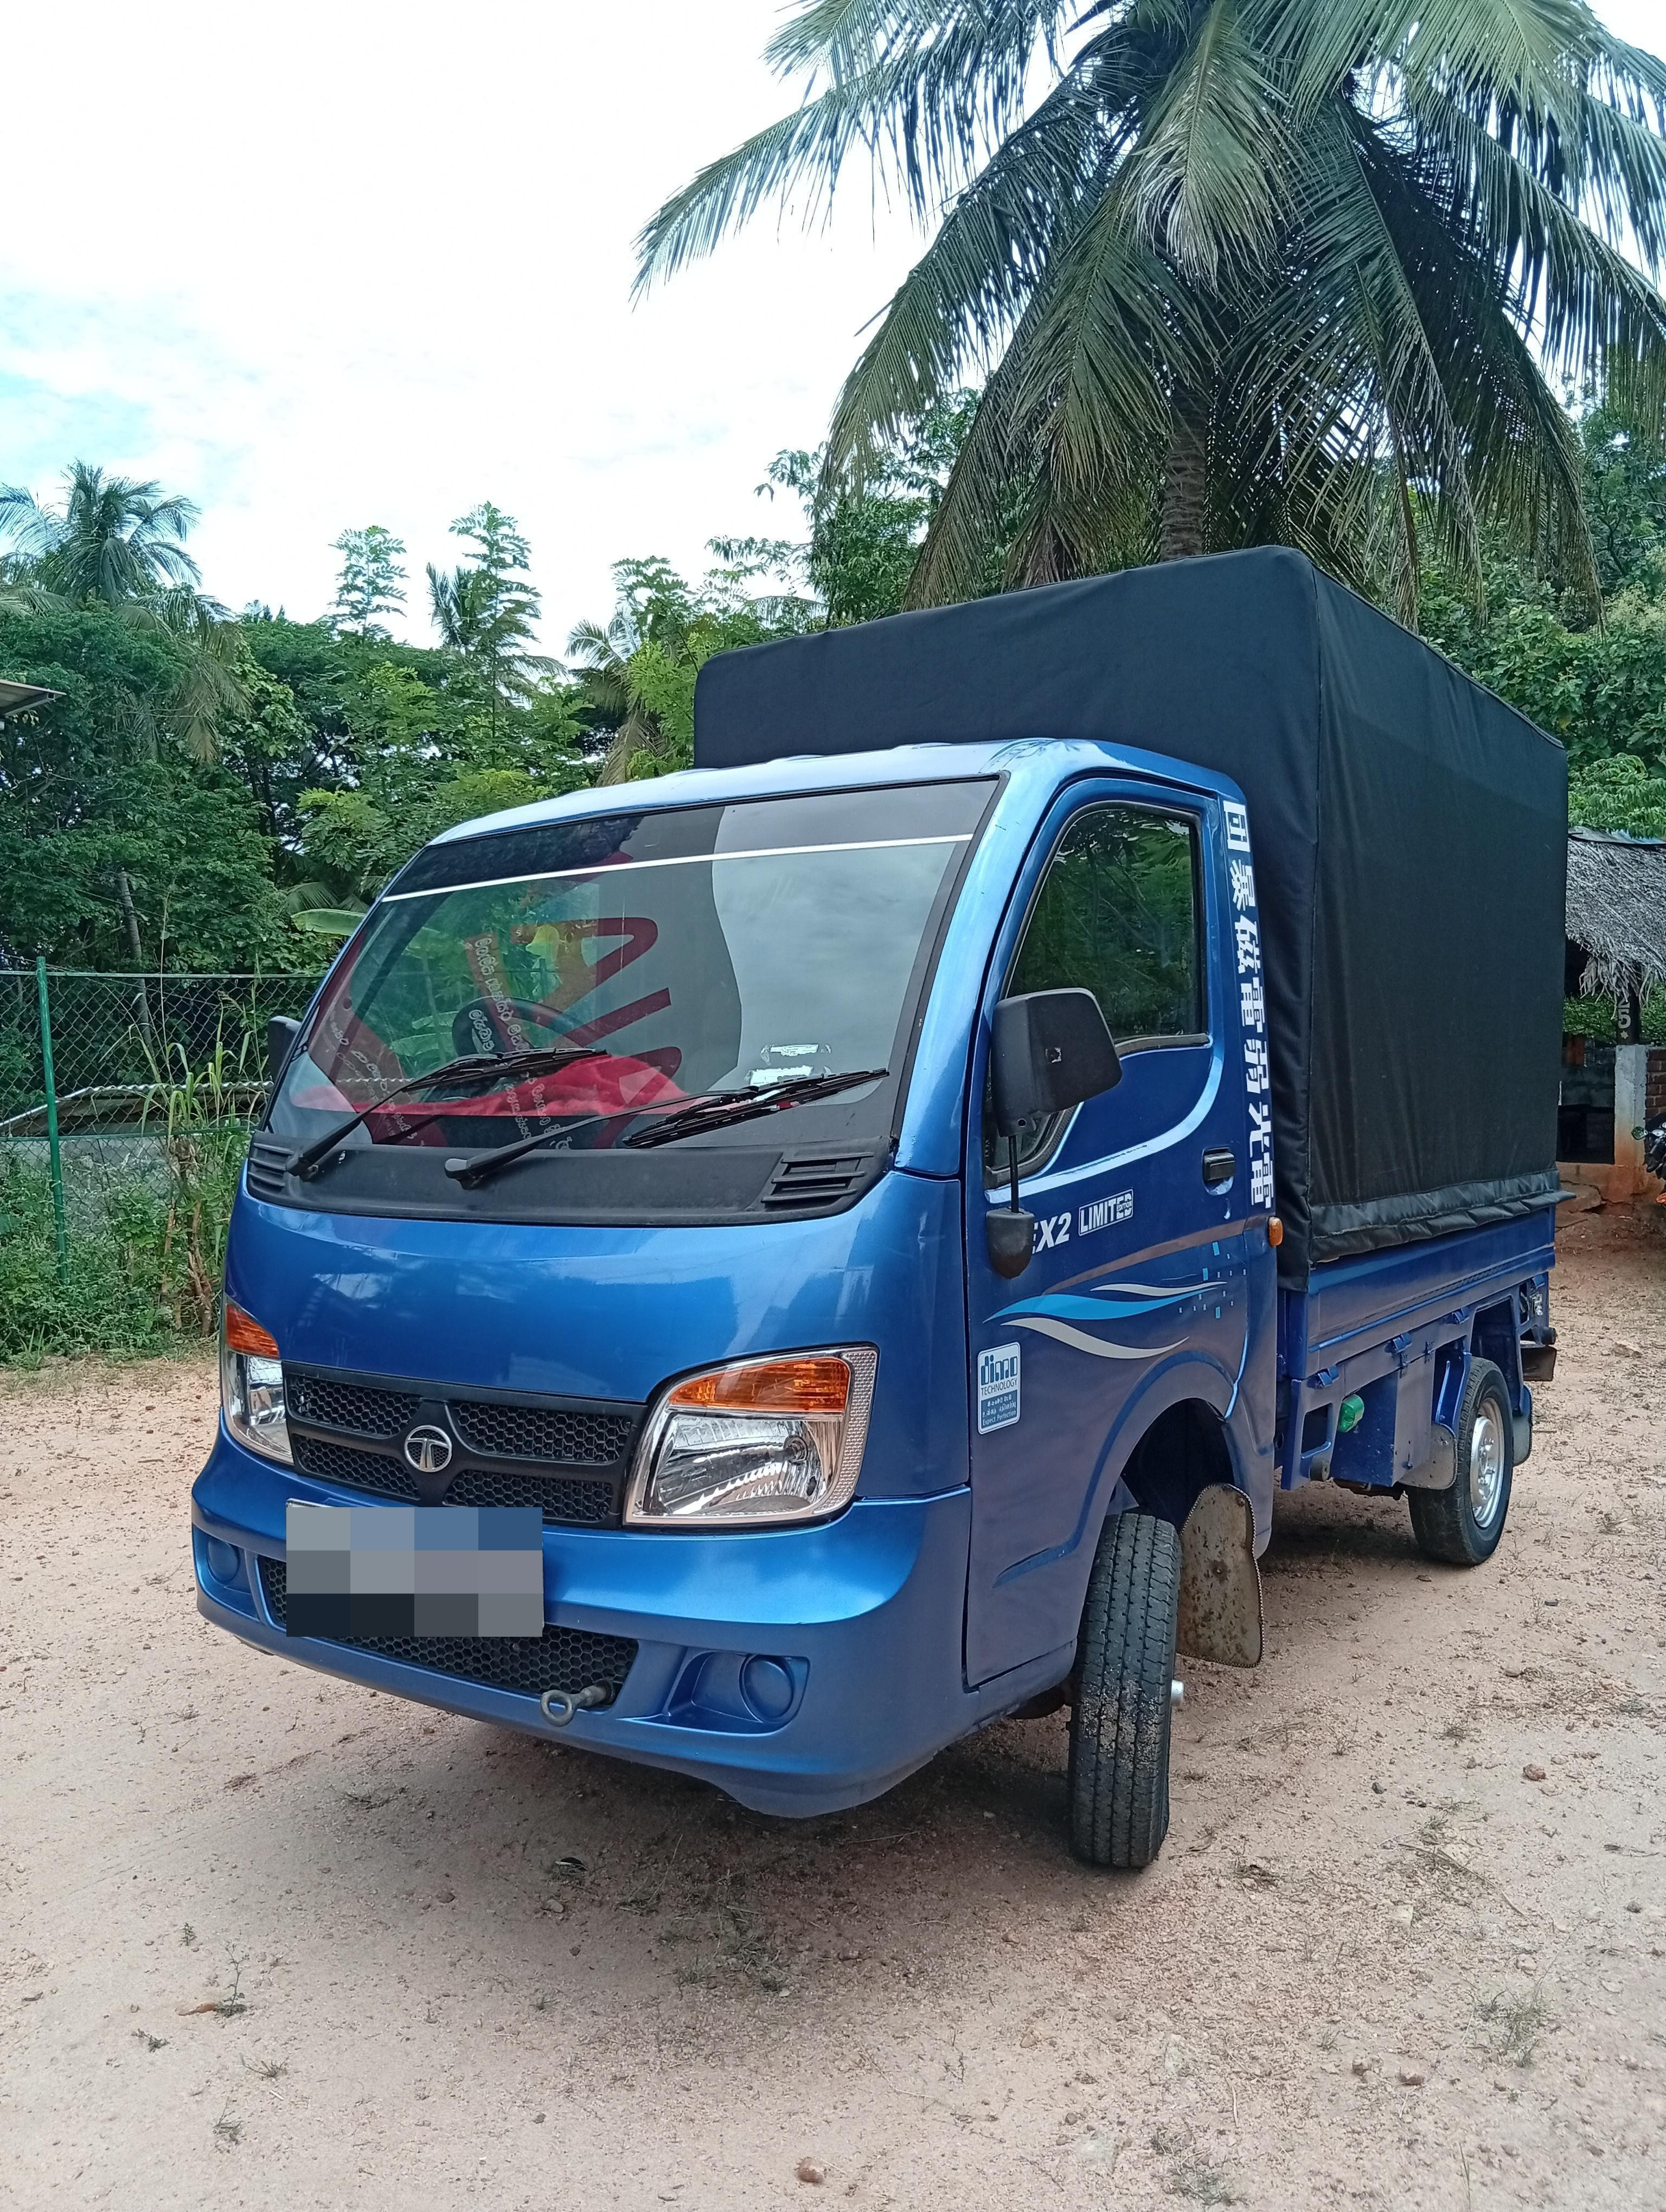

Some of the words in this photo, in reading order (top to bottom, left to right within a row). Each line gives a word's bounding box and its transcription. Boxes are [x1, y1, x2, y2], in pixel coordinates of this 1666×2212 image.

[1117, 1200, 1133, 1212] EDITION
[1032, 1212, 1072, 1254] X2
[1080, 1193, 1132, 1233] LIMITED
[981, 1354, 1018, 1386] dimo
[981, 1378, 1017, 1396] TECHNOLOGY
[982, 1416, 996, 1426] Expect
[996, 1410, 1016, 1422] Perfection
